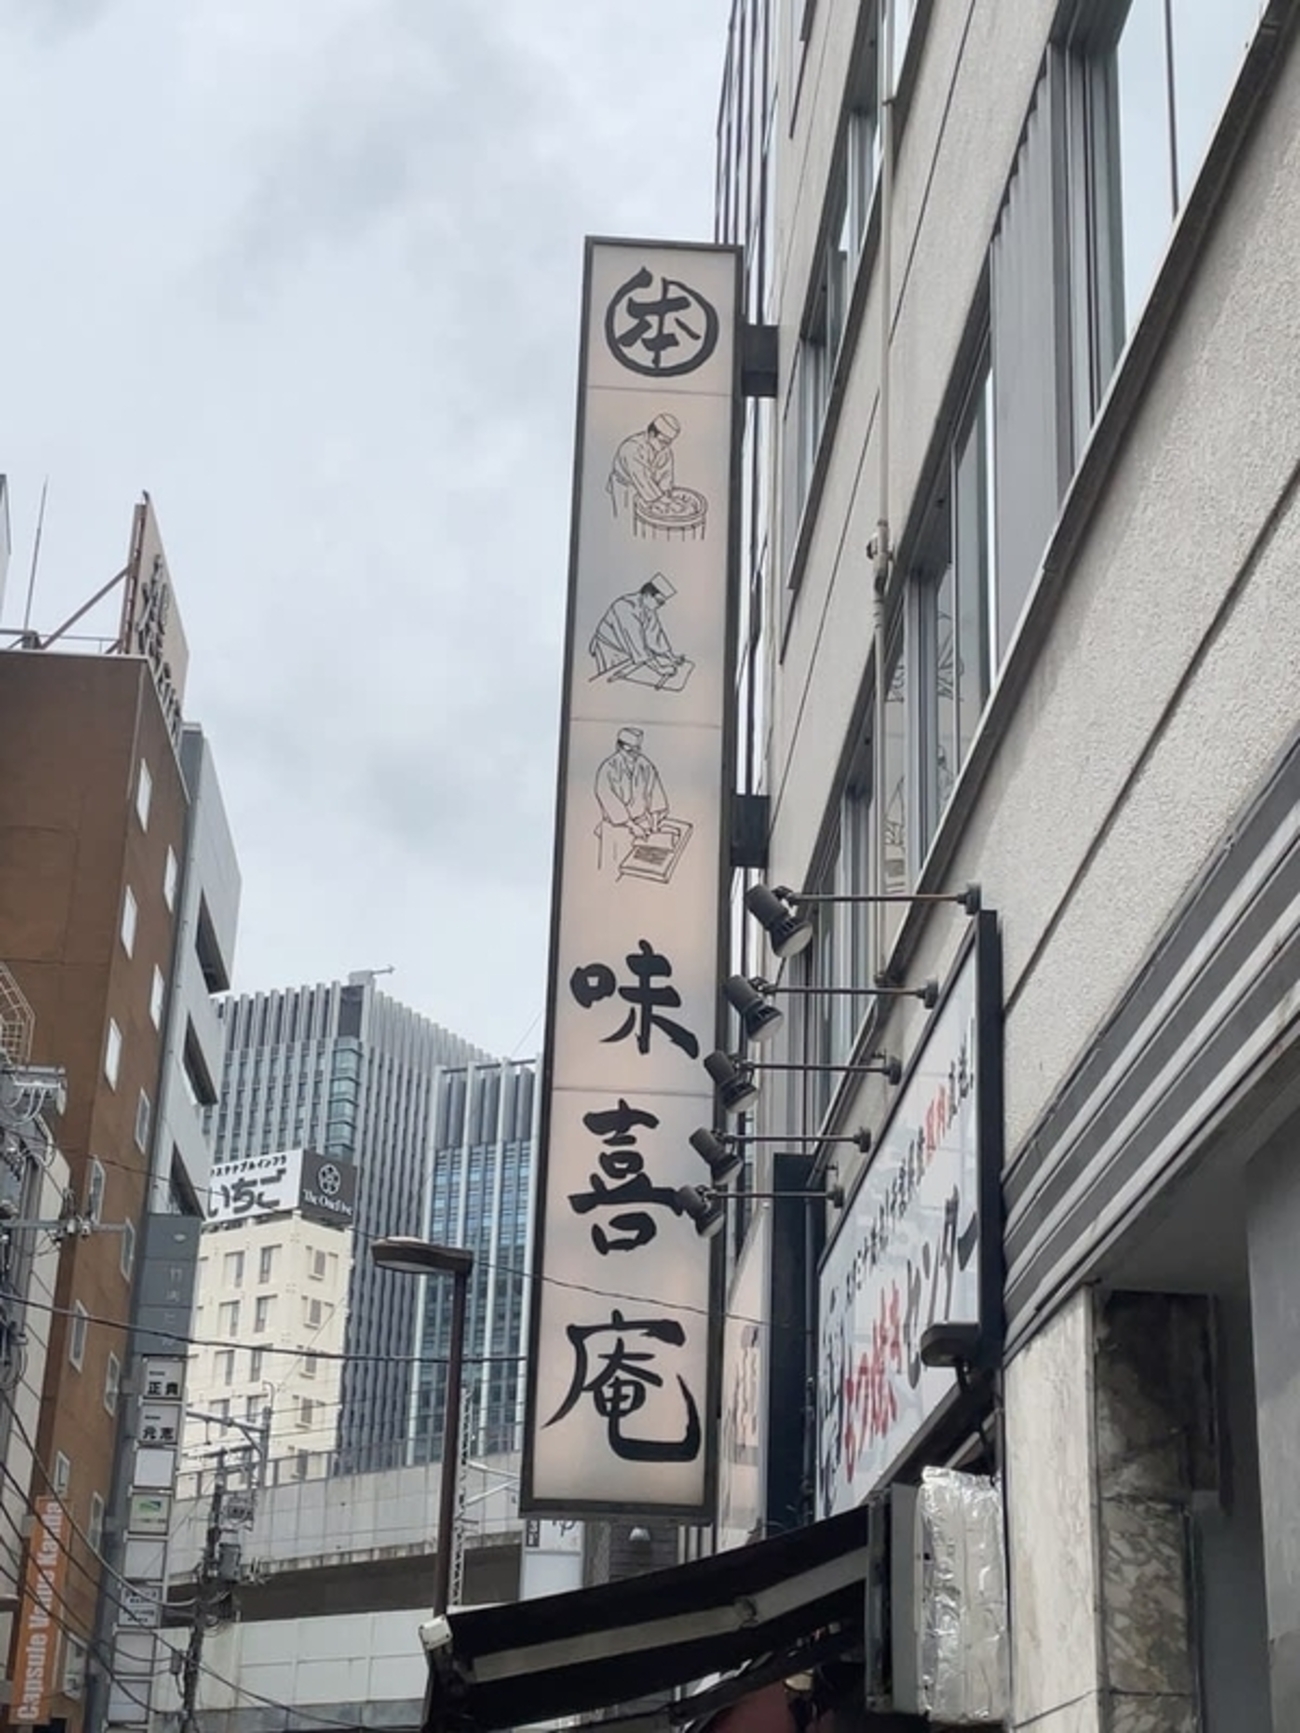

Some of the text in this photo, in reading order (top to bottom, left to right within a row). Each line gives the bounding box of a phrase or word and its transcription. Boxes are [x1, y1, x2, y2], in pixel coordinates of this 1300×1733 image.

[208, 1167, 287, 1218] いちご
[302, 1188, 317, 1205] The
[541, 939, 701, 1463] 味喜庵
[16, 1501, 63, 1721] Capsule Value Kanda
